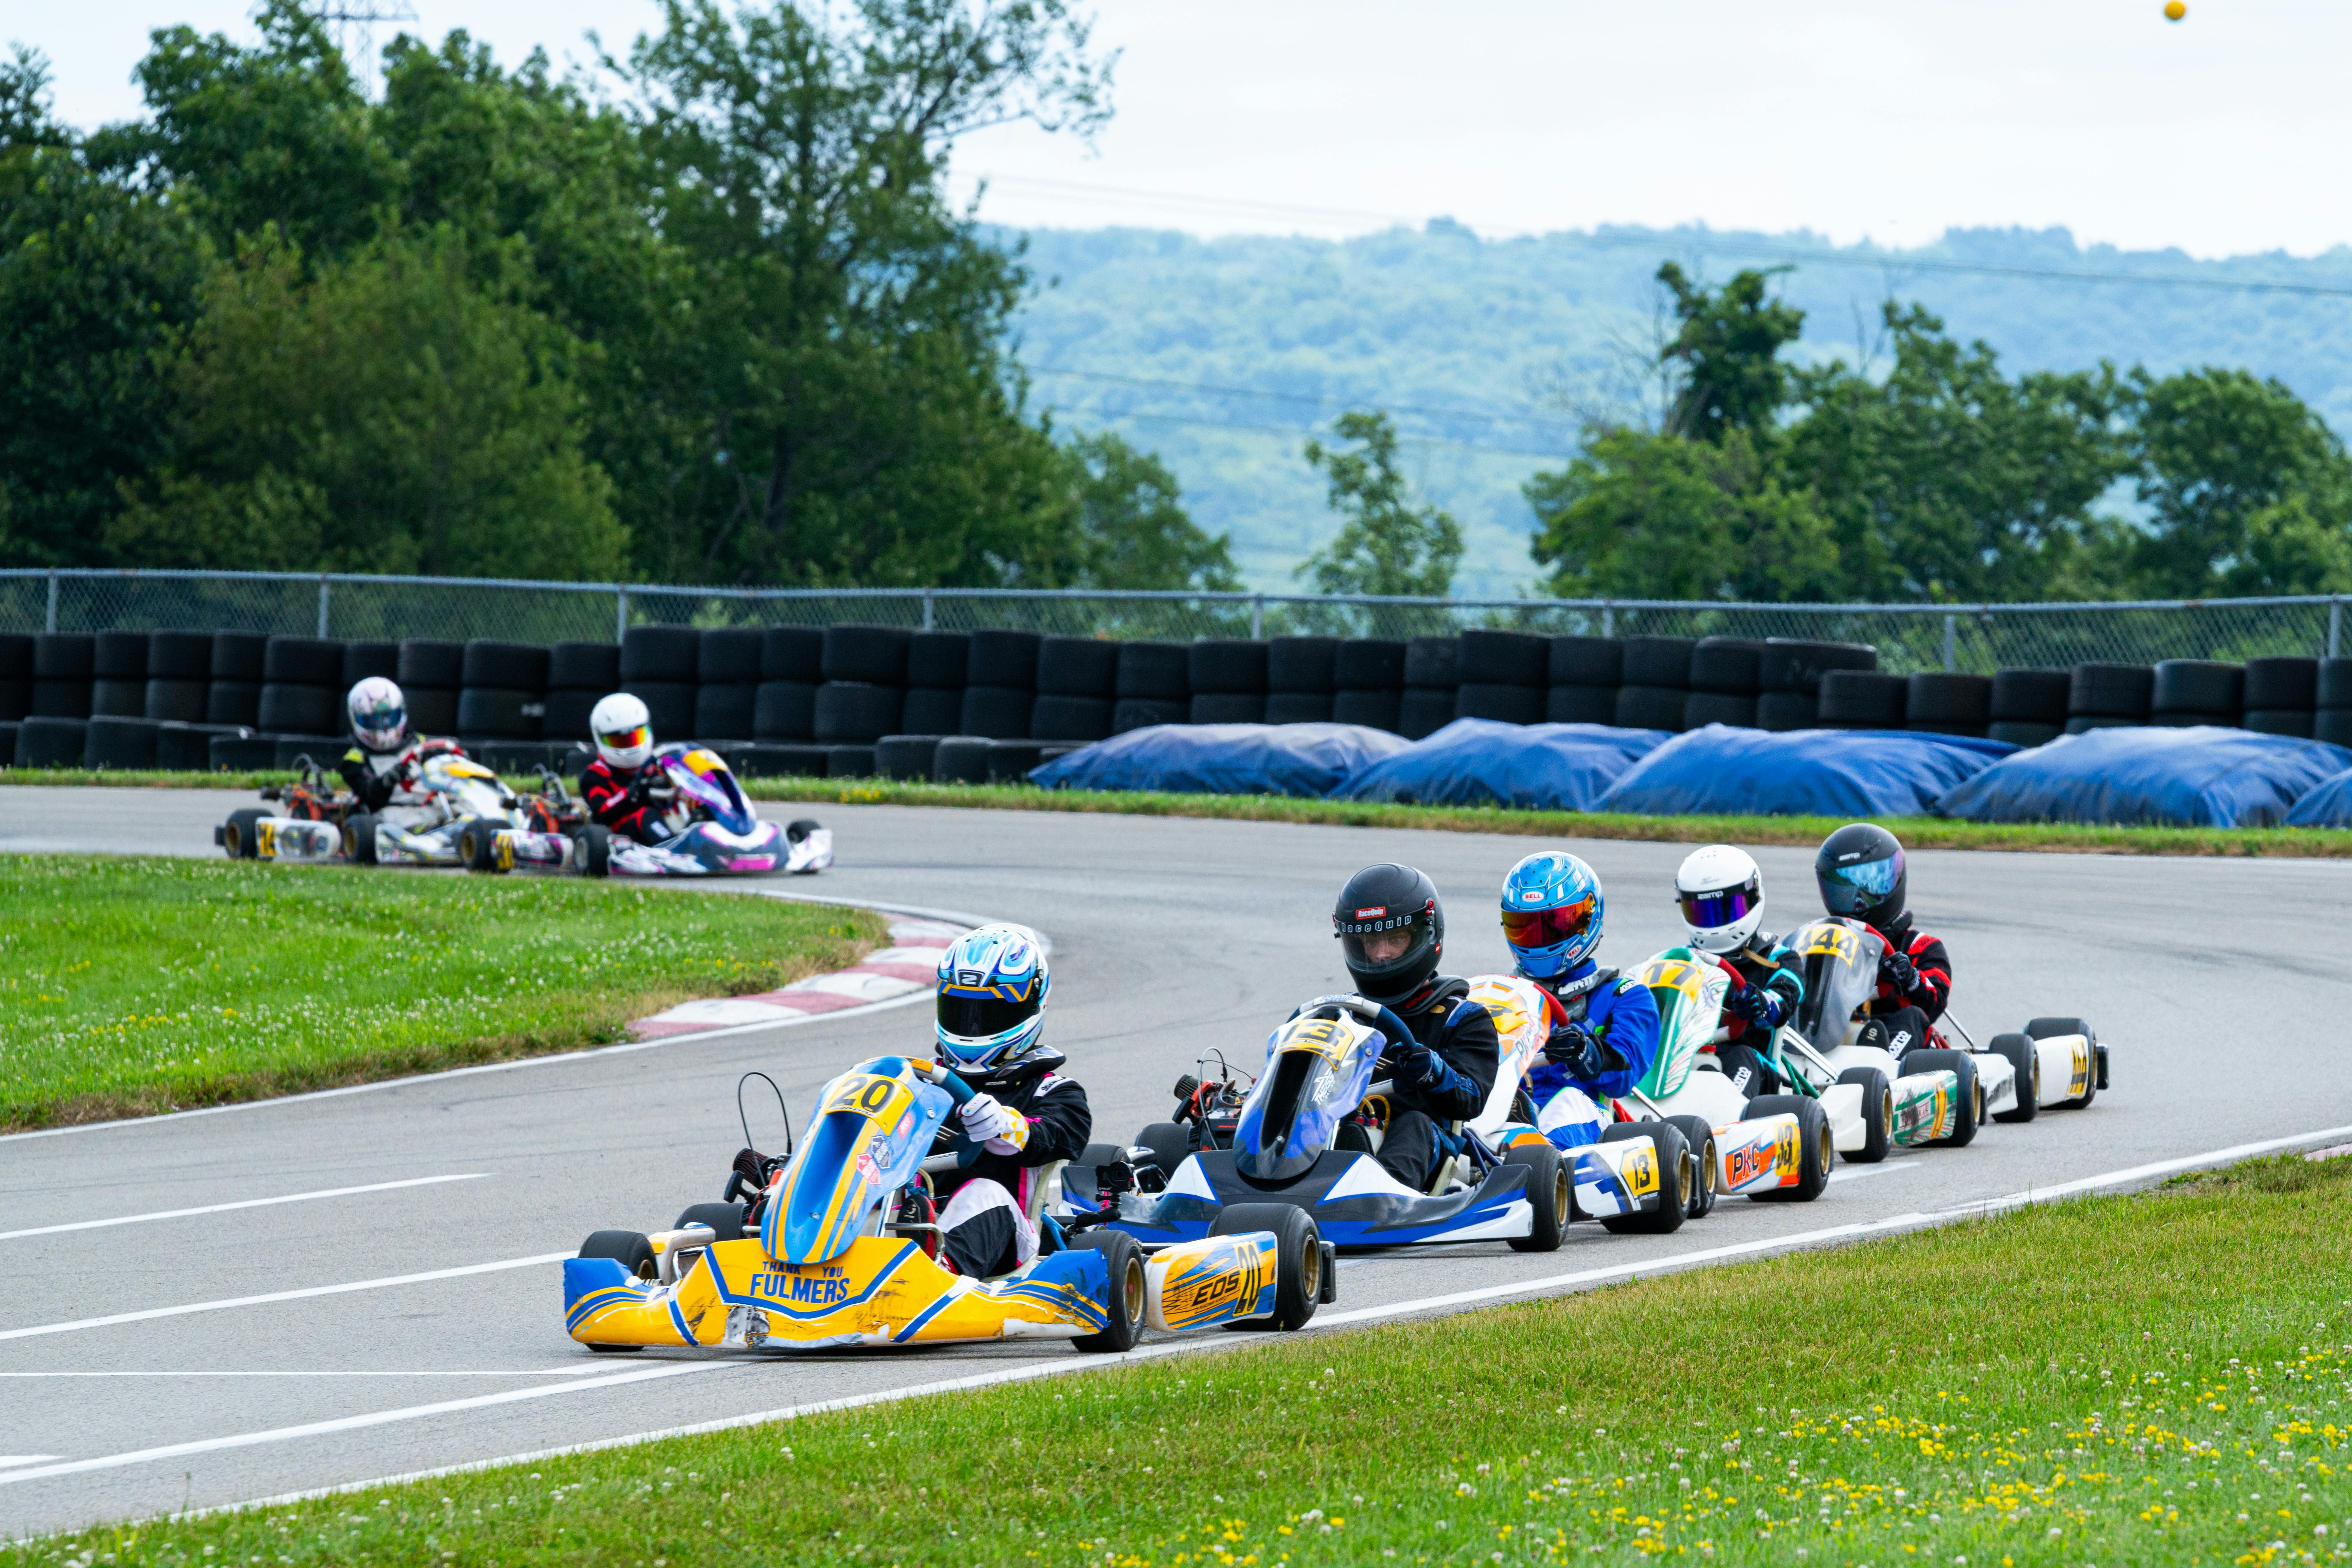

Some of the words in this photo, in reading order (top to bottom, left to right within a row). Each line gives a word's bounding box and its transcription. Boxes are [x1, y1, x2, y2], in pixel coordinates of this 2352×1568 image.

[1341, 915, 1411, 933] RaceQuip
[1358, 908, 1384, 917] RaceQuip
[1568, 947, 1581, 957] BELL
[961, 974, 977, 985] 2
[1644, 962, 1696, 986] 17
[829, 1077, 895, 1113] 20
[1732, 1142, 1760, 1182] PKC
[1777, 1125, 1793, 1170] 33
[1632, 1154, 1650, 1190] 13
[762, 1261, 801, 1274] THANK
[823, 1266, 843, 1278] YOU
[1237, 1244, 1261, 1313] 20
[750, 1274, 850, 1303] FULMERS
[1192, 1271, 1240, 1307] EOS
